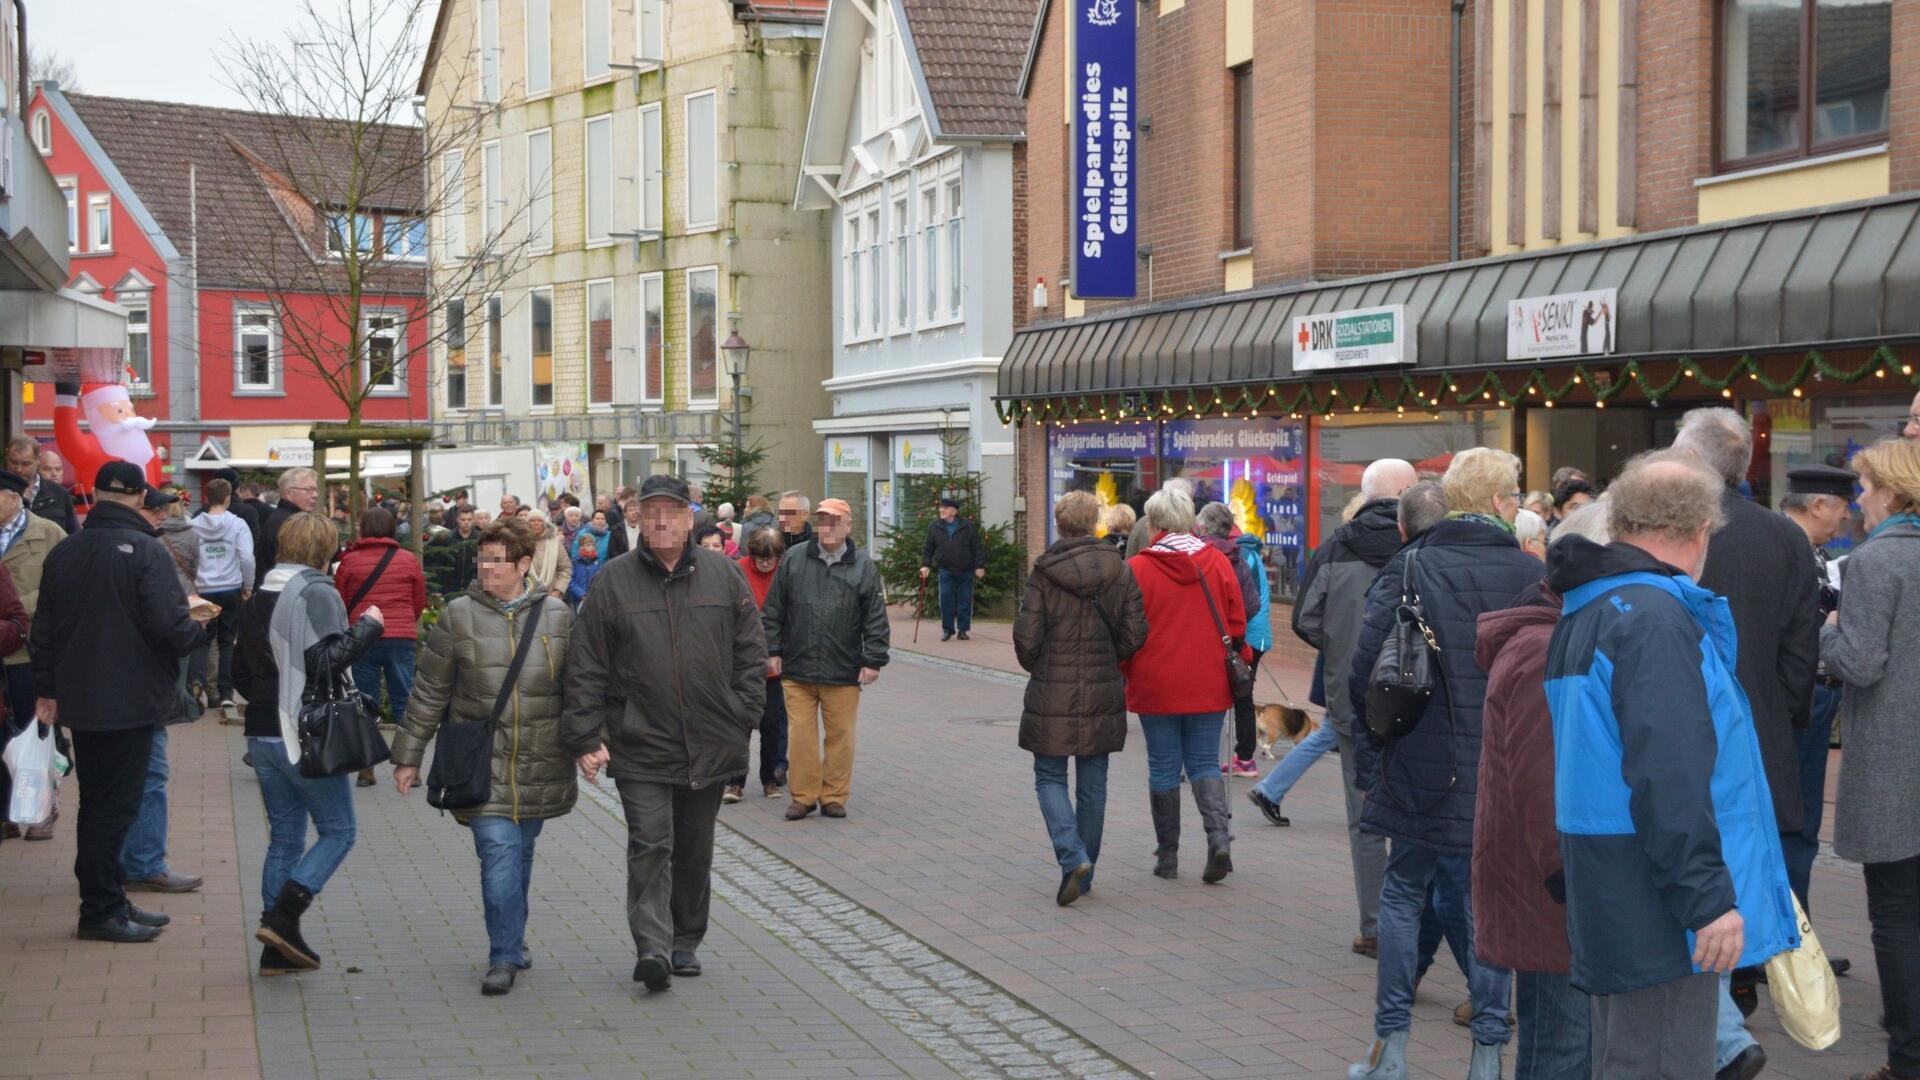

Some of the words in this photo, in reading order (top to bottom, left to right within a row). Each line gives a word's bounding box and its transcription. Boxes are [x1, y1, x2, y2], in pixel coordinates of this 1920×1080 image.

[1082, 62, 1104, 258] Spielparadies
[1110, 87, 1131, 235] Glückspilz
[1312, 320, 1334, 350] DRK
[1336, 319, 1392, 337] SOZIALSTATIONEN
[1057, 433, 1105, 452] Spielparadies
[1107, 432, 1147, 452] Glückspilz
[1173, 431, 1234, 451] Spielparadies
[1238, 428, 1290, 451] Glückspilz
[1266, 472, 1298, 485] Goldspiel
[1266, 502, 1298, 515] Touch
[1266, 533, 1298, 545] Billard
